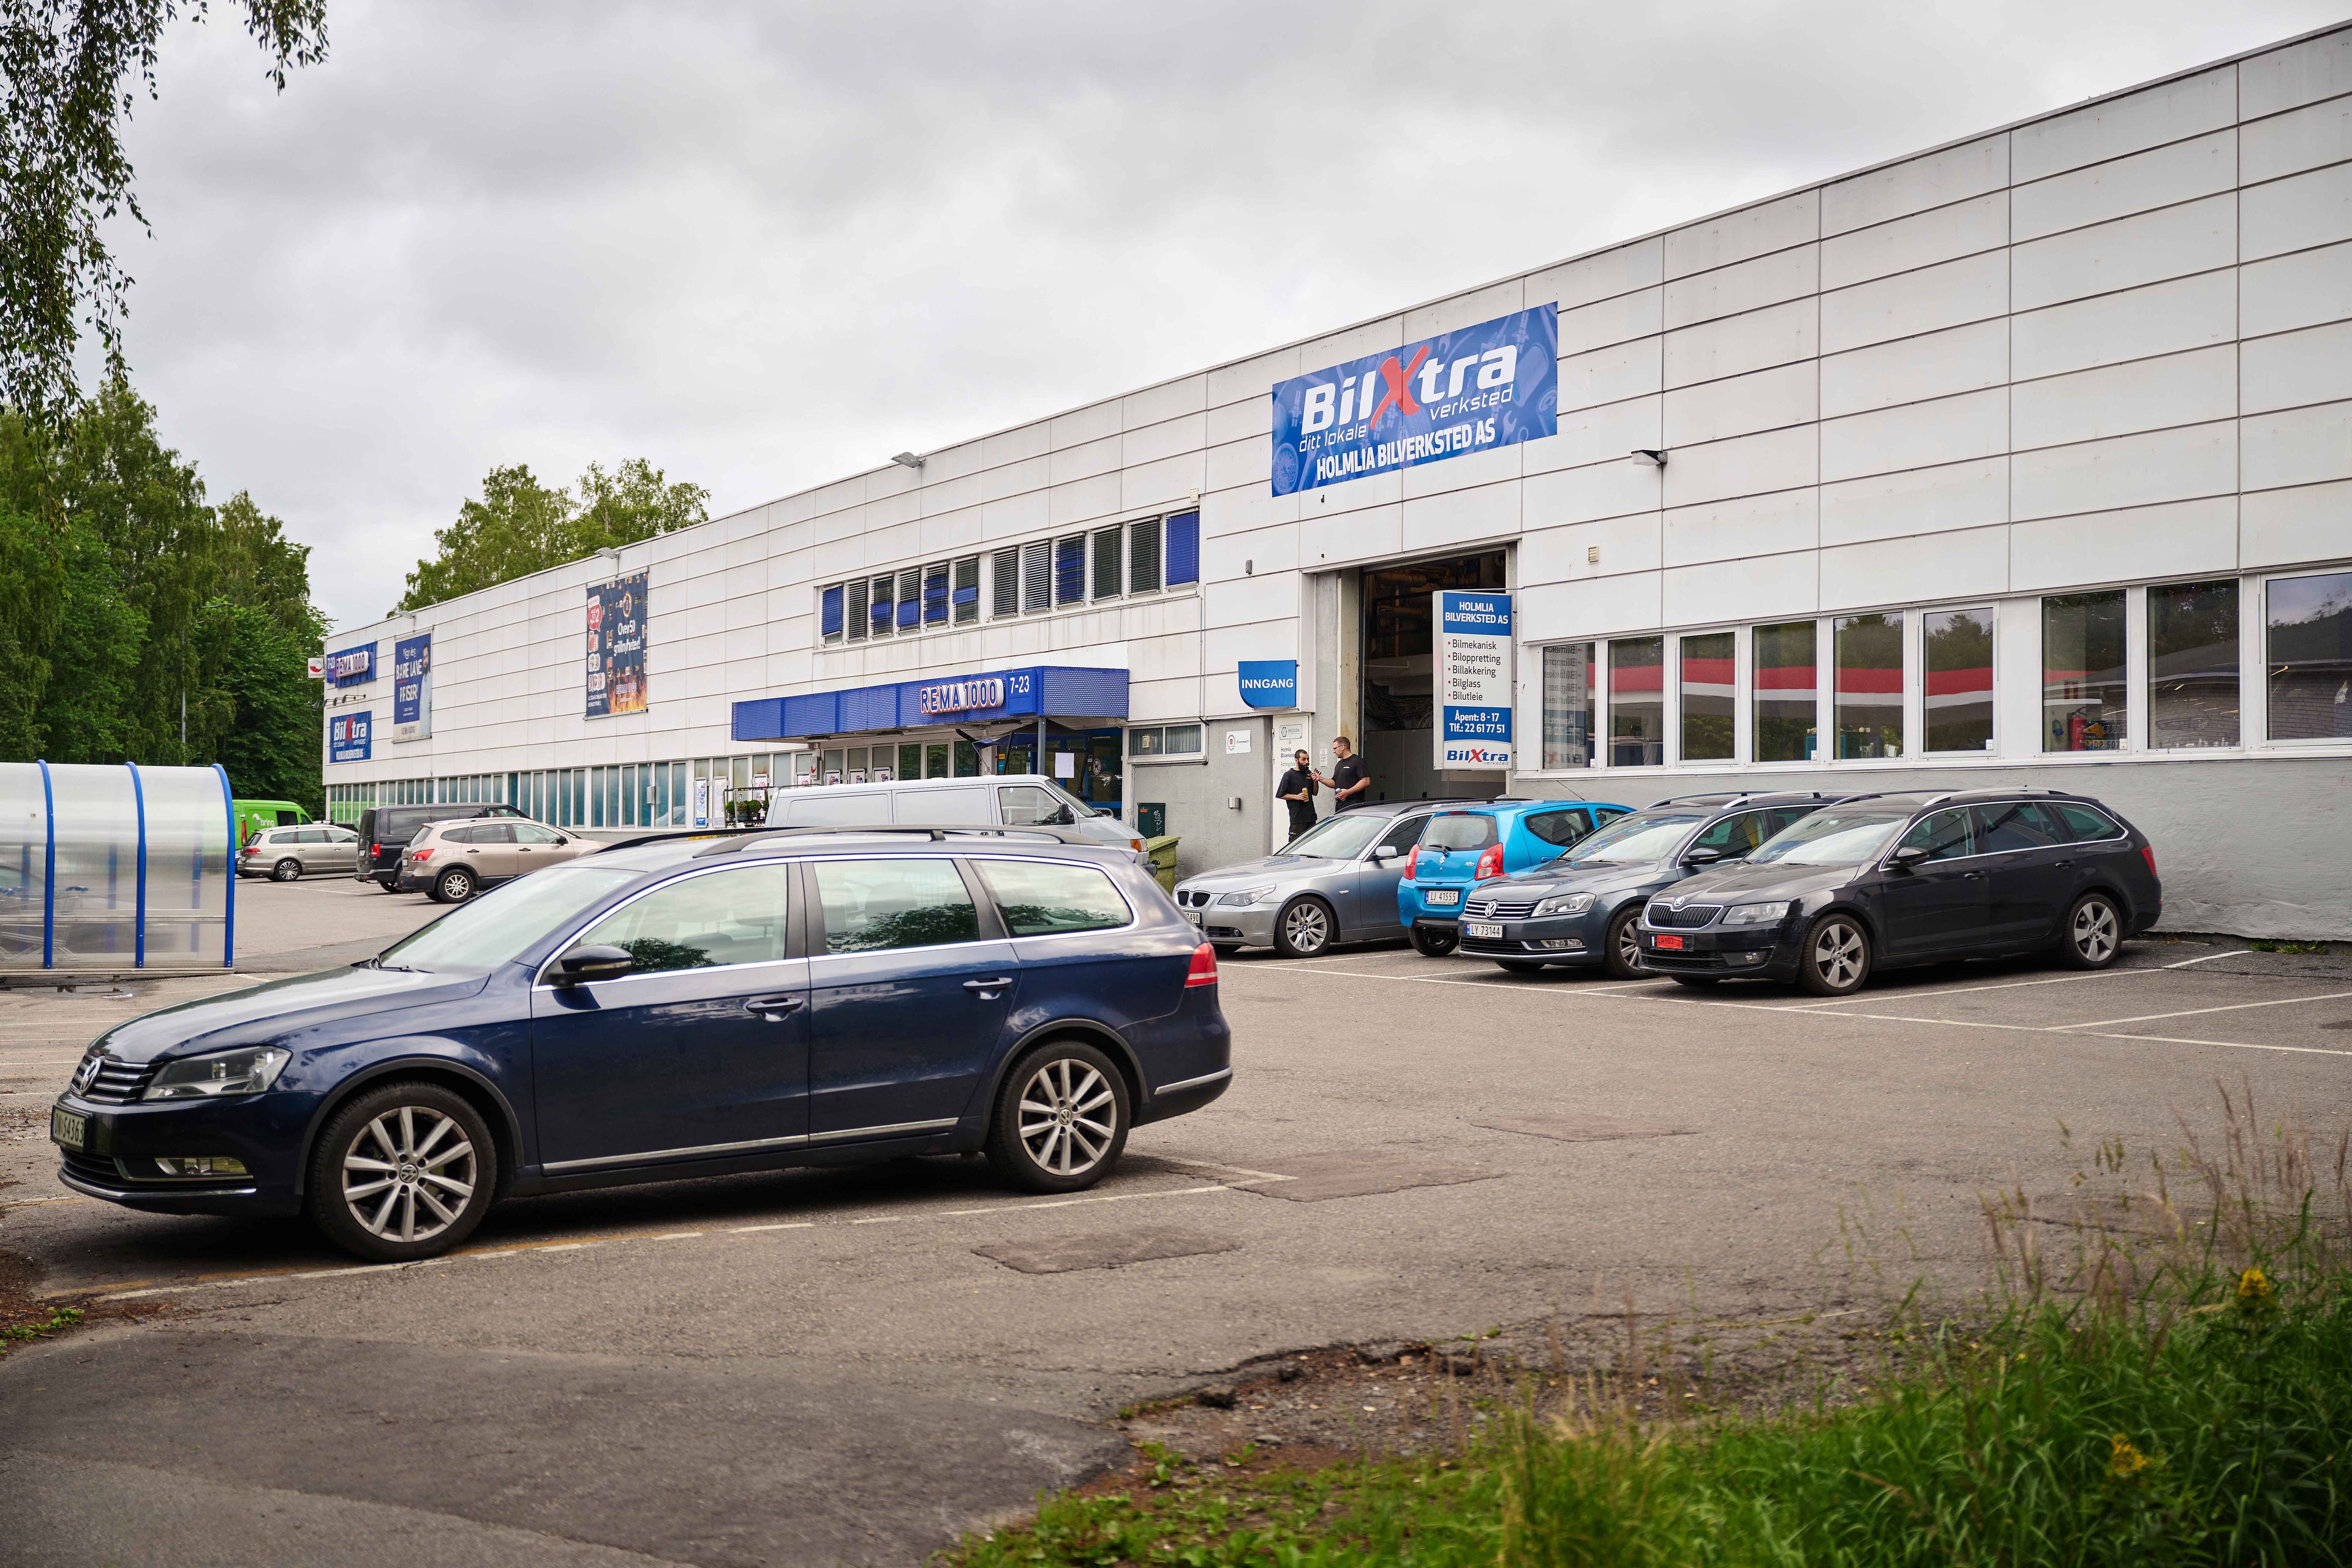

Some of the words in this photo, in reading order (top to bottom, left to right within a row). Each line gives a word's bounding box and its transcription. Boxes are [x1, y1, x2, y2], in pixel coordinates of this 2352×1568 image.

[1301, 345, 1517, 435] BilXtra
[1430, 384, 1513, 420] verksted
[1299, 434, 1321, 453] ditt
[1324, 424, 1367, 447] lokale
[1317, 451, 1376, 481] HOLMLIA
[1378, 423, 1472, 467] BILVERKSTED
[1475, 417, 1495, 446] AS
[1459, 601, 1494, 612] HOLMLIA
[1445, 612, 1496, 624] BILVERKSTED
[1498, 614, 1509, 624] AS
[618, 622, 630, 635] Over
[1452, 639, 1497, 650] Bilmekanisk
[1452, 652, 1501, 666] Biloppretting
[1452, 665, 1496, 678] Billakkering
[1009, 675, 1030, 694] 7-23
[1242, 678, 1294, 689] INNGANG
[1452, 677, 1481, 690] Bilglass
[920, 684, 961, 714] REMA
[963, 678, 997, 709] 1000
[1453, 691, 1483, 701] Bilutleie
[1455, 709, 1479, 723] Åpent:
[1480, 712, 1486, 722] 8
[1491, 713, 1499, 722] 17
[334, 715, 367, 744] BilXtra
[1449, 723, 1463, 732] Tlf.:
[1464, 723, 1475, 733] 22
[1476, 724, 1485, 733] 61
[1486, 724, 1495, 733] 77
[1496, 724, 1505, 733] 51
[1447, 748, 1509, 763] BilXtra
[1431, 892, 1436, 900] LJ
[1439, 892, 1456, 901] 41555
[1471, 925, 1479, 935] LY
[1481, 926, 1500, 936] 73144
[62, 1116, 84, 1144] 54363
